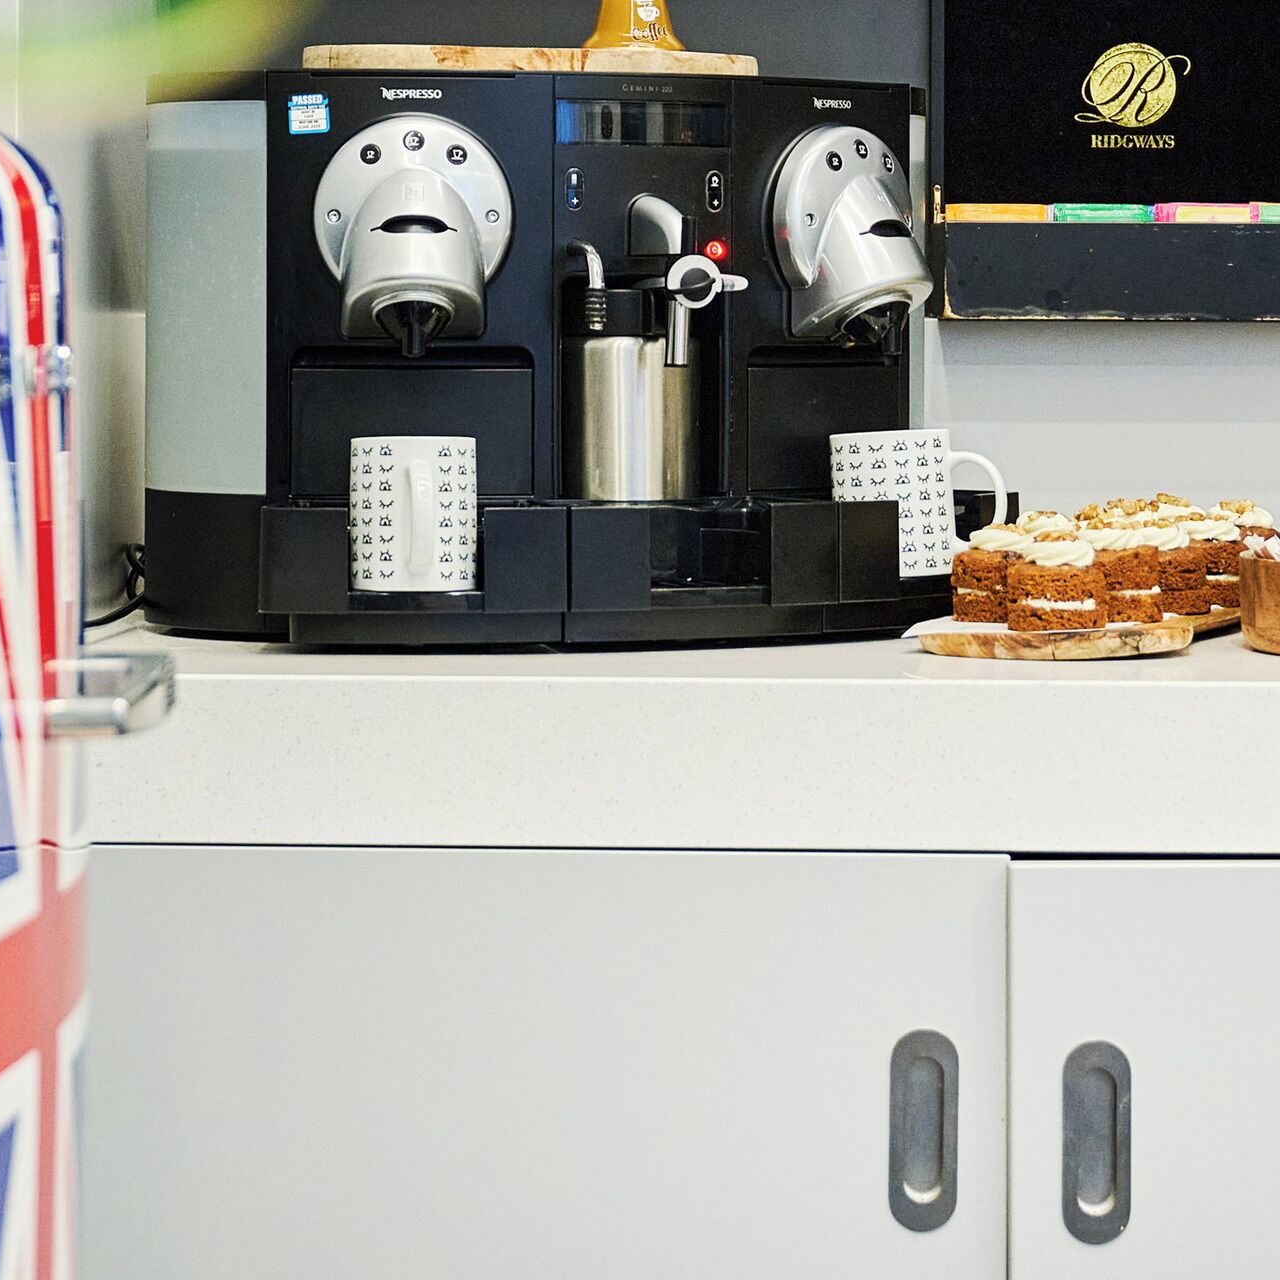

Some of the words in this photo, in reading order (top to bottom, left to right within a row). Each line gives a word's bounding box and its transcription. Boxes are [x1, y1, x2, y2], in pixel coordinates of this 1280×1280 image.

[632, 22, 668, 41] Coffee
[292, 94, 324, 105] PASSED
[380, 87, 442, 100] NESPRESSO
[812, 97, 851, 109] NESPRESSO
[1090, 134, 1175, 148] RIDGWAYS
